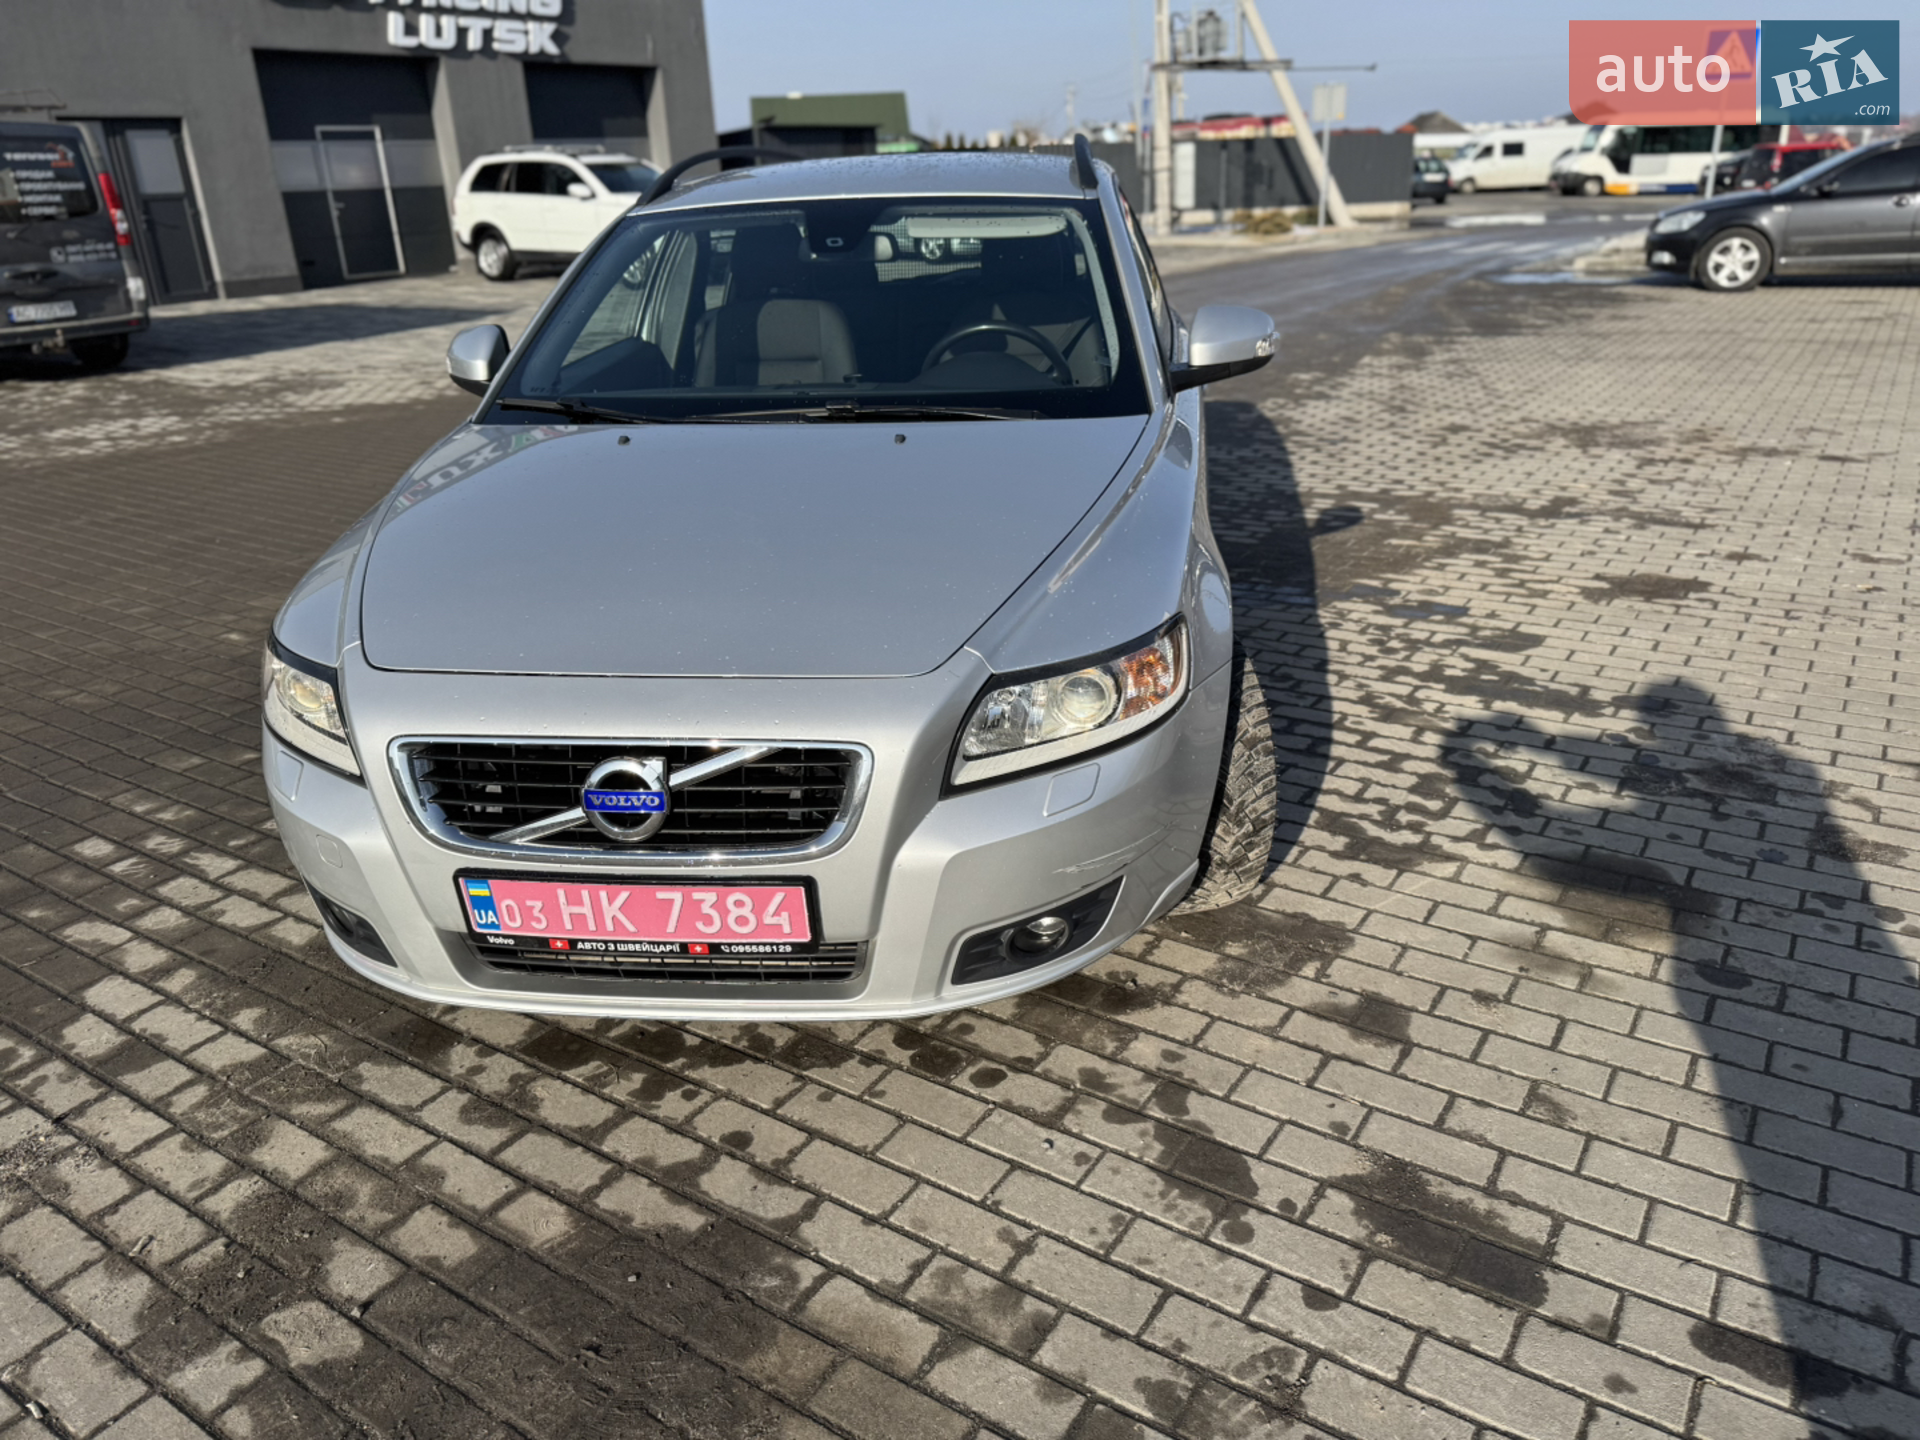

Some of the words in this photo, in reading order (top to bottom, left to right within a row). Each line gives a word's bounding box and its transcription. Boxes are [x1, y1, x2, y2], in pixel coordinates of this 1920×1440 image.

[387, 10, 561, 55] LUTSK
[588, 794, 661, 806] VOLVO
[474, 909, 499, 925] UA
[501, 898, 549, 930] 03
[557, 888, 638, 933] HK
[655, 891, 793, 934] 7384
[486, 935, 515, 945] Volvo
[577, 941, 606, 951] АВТО
[616, 942, 681, 954] ШВЕЙЦАРІЇ
